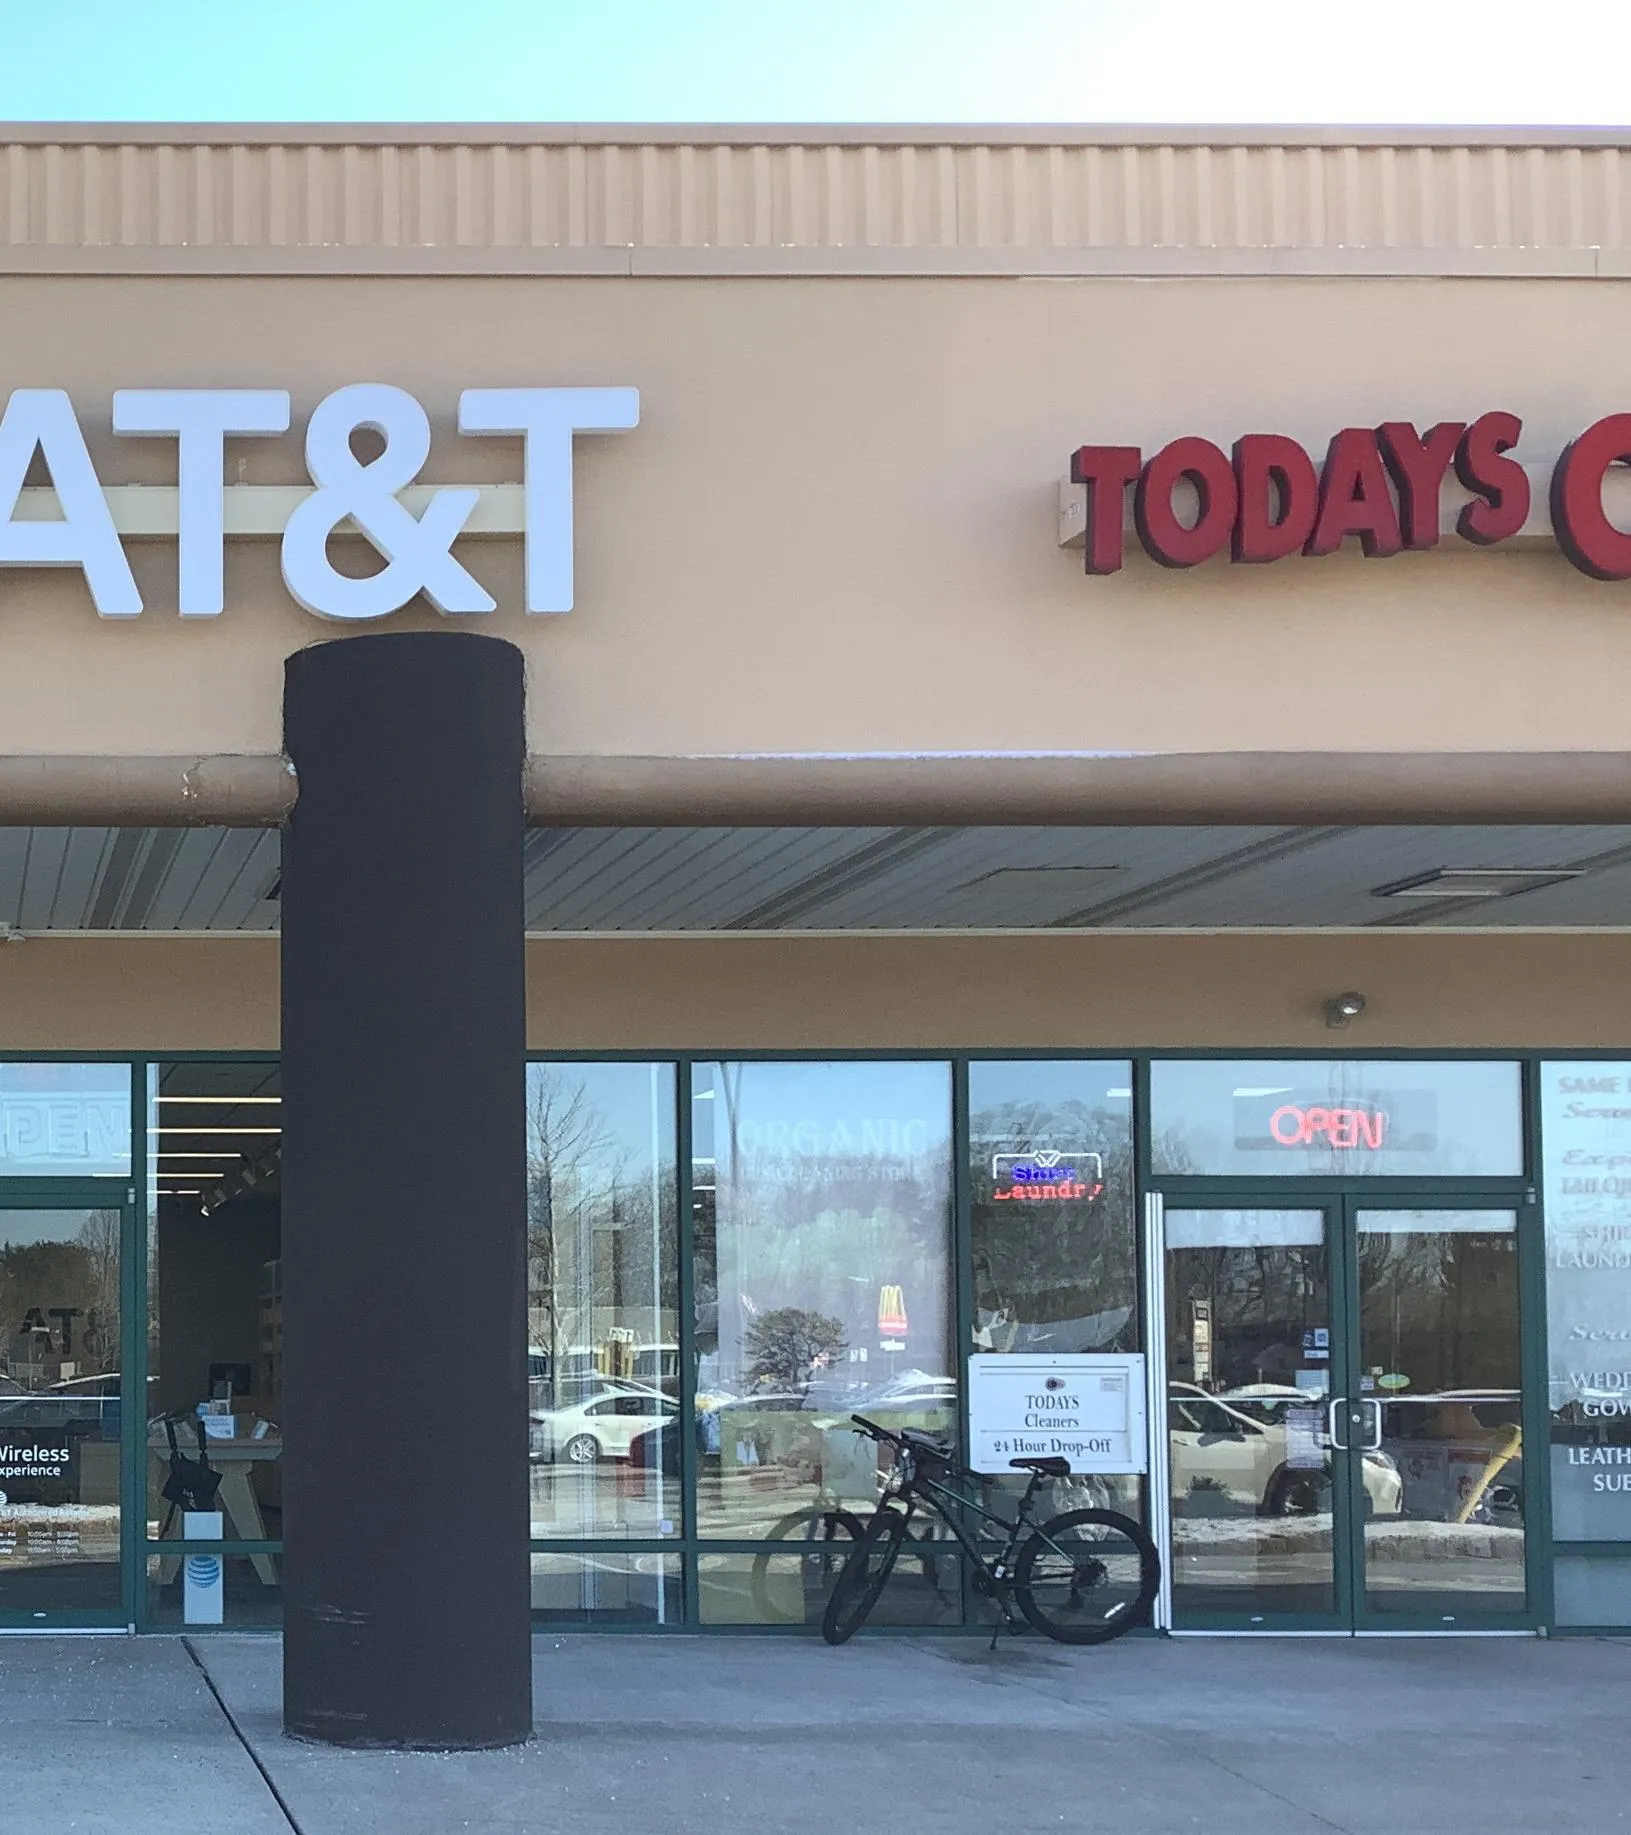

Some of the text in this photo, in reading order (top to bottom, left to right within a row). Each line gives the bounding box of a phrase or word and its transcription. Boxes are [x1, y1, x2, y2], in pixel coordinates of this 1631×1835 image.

[1071, 411, 1530, 576] TODAYS
[737, 1117, 928, 1156] ORGANIC
[1270, 1105, 1384, 1149] OPEN
[1024, 1394, 1080, 1410] TODAYS
[1024, 1413, 1080, 1428] Cleaners
[993, 1438, 1112, 1456] 24 Hour Drop-Off
